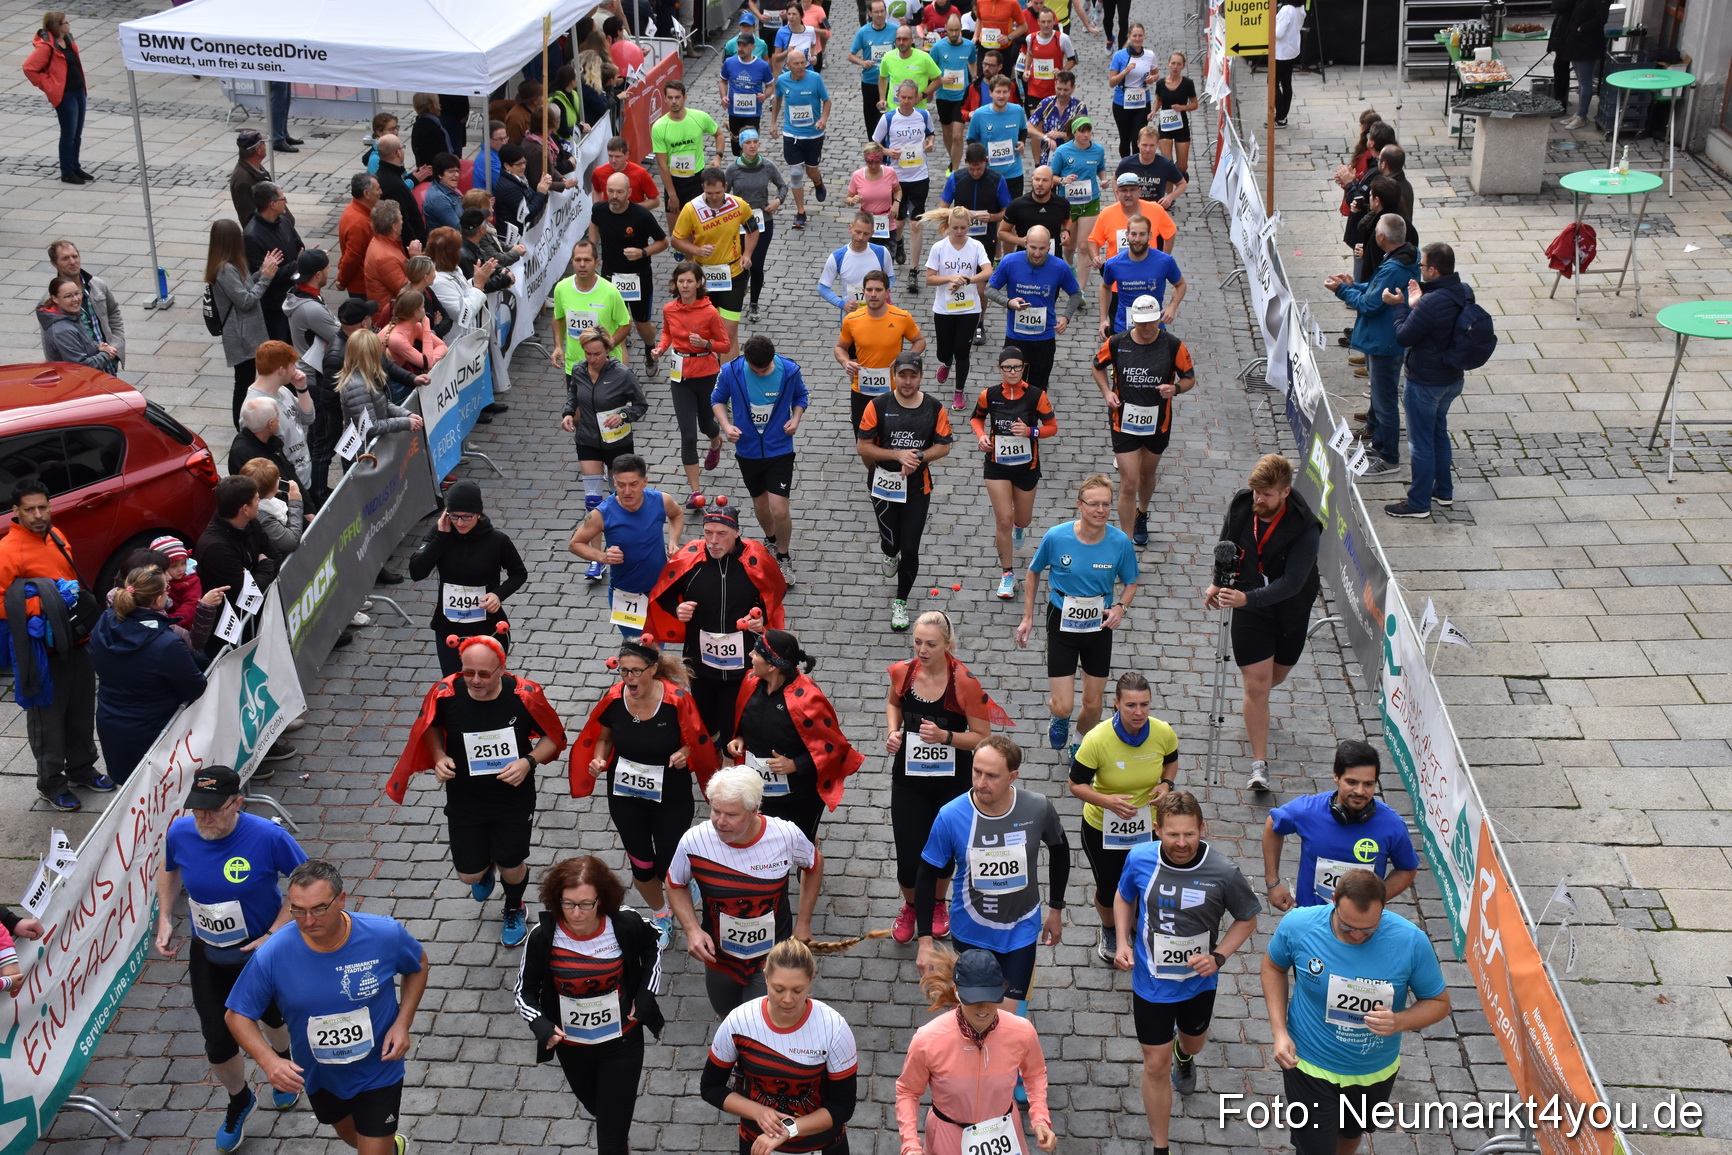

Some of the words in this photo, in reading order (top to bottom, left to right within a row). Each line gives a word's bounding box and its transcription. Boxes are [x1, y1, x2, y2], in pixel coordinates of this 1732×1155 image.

[1227, 0, 1269, 14] Jugend
[1240, 13, 1262, 26] lauf
[138, 33, 185, 50] BMW
[190, 37, 328, 61] ConnectedDrive
[140, 51, 196, 68] Vernetzt,
[198, 58, 216, 68] um
[218, 58, 238, 69] frei
[241, 60, 254, 70] zu
[257, 61, 286, 73] sein.
[906, 151, 916, 160] 54
[992, 148, 1010, 157] 2539
[675, 162, 690, 170] 212
[1068, 188, 1088, 196] 2441
[702, 220, 722, 232] MAX
[722, 212, 742, 223] BÖGL
[706, 272, 727, 280] 2608
[616, 282, 636, 290] 2920
[954, 292, 966, 301] 39
[570, 318, 594, 328] 2193
[1019, 314, 1042, 324] 2104
[1122, 368, 1149, 376] HECK
[862, 376, 886, 386] 2120
[1126, 376, 1162, 384] DESIGN
[1128, 414, 1152, 424] 2180
[890, 431, 916, 439] HECK
[342, 436, 356, 454] swn
[890, 438, 926, 448] DESIGN
[1000, 444, 1025, 456] 2181
[877, 476, 902, 490] 2228
[288, 549, 336, 642] BOCK
[449, 596, 480, 608] 2494
[625, 600, 638, 613] 71
[1068, 607, 1098, 620] 2900
[224, 615, 236, 637] swn
[705, 642, 737, 656] 2139
[474, 742, 510, 758] 2518
[913, 746, 948, 760] 2565
[921, 762, 940, 770] Claudia
[620, 772, 655, 790] 2155
[1110, 820, 1146, 834] 2484
[1119, 836, 1138, 844] Monika
[750, 862, 784, 871] NEUMARKT
[979, 860, 1020, 876] 2208
[992, 880, 1008, 888] Horst
[29, 880, 47, 909] swn
[198, 914, 236, 932] 3000
[728, 928, 766, 944] 2780
[344, 958, 380, 970] NEUMARKTER
[344, 964, 373, 975] STADTLAUF
[80, 974, 131, 1056] Service-Line:
[570, 1008, 612, 1027] 2755
[316, 1024, 363, 1046] 2339
[1532, 1006, 1555, 1057] Neumarkts
[788, 1047, 822, 1056] NEUMARKT
